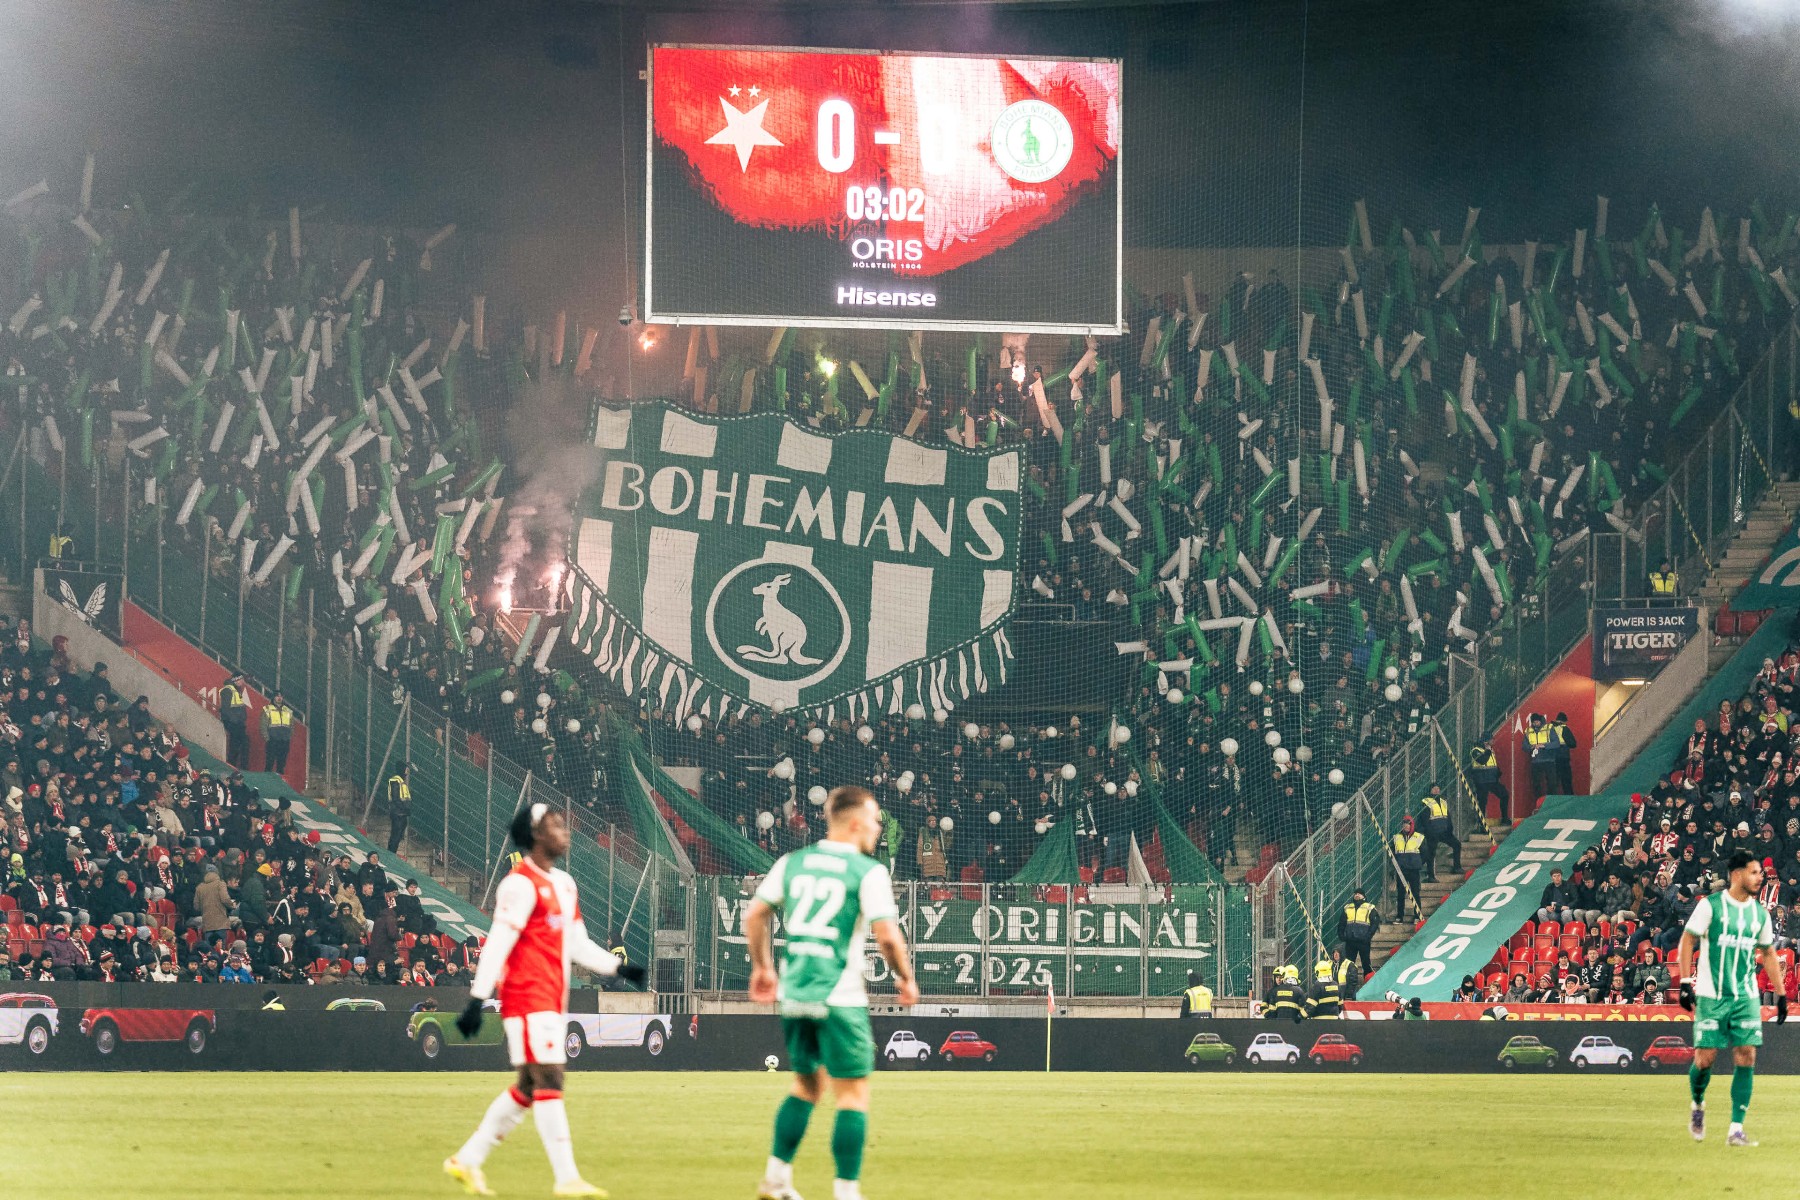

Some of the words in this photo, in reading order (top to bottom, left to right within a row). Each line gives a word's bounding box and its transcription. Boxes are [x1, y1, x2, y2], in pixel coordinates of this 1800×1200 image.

[817, 99, 855, 173] 0
[846, 186, 925, 222] 03:02
[851, 238, 923, 261] ORIS
[837, 286, 937, 307] Hisense
[601, 460, 1008, 561] BOHEMIANS
[1606, 617, 1645, 628] POWER
[1646, 616, 1657, 627] IS
[1611, 632, 1678, 650] TIGER
[787, 874, 848, 940] 22
[1396, 818, 1598, 986] Hisense
[954, 952, 1053, 986] 2025
